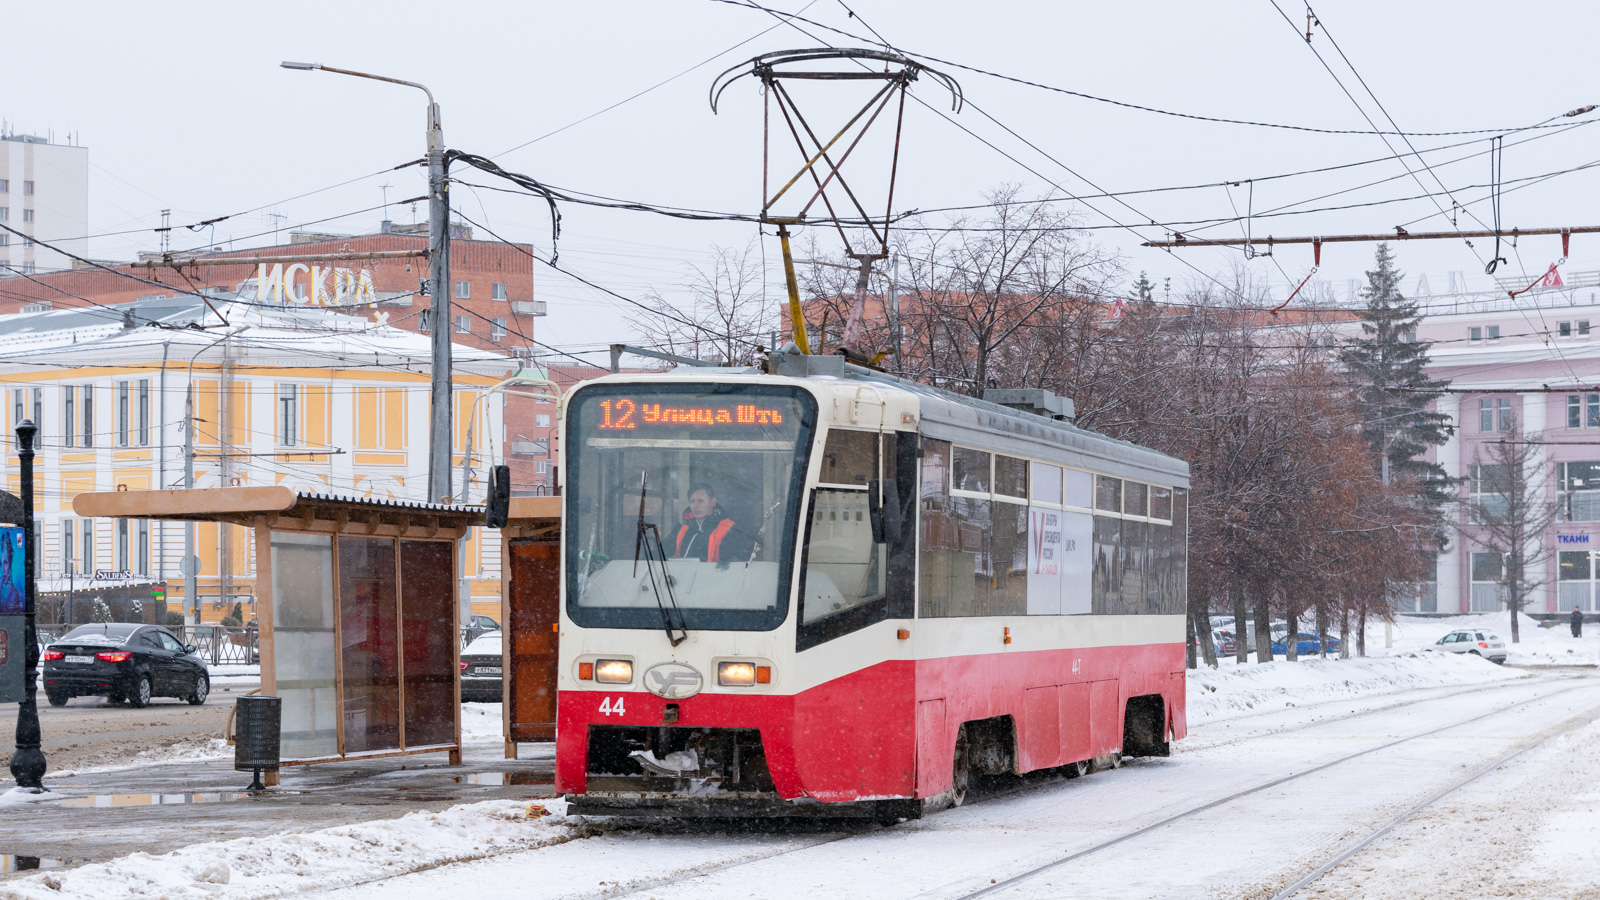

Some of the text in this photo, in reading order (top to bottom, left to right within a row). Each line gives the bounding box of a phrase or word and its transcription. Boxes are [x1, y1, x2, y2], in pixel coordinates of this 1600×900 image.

[257, 262, 379, 309] ИСКРА
[600, 398, 783, 429] 12 Улица Шть
[1557, 535, 1589, 544] ТКАНИ
[598, 696, 626, 717] 44
